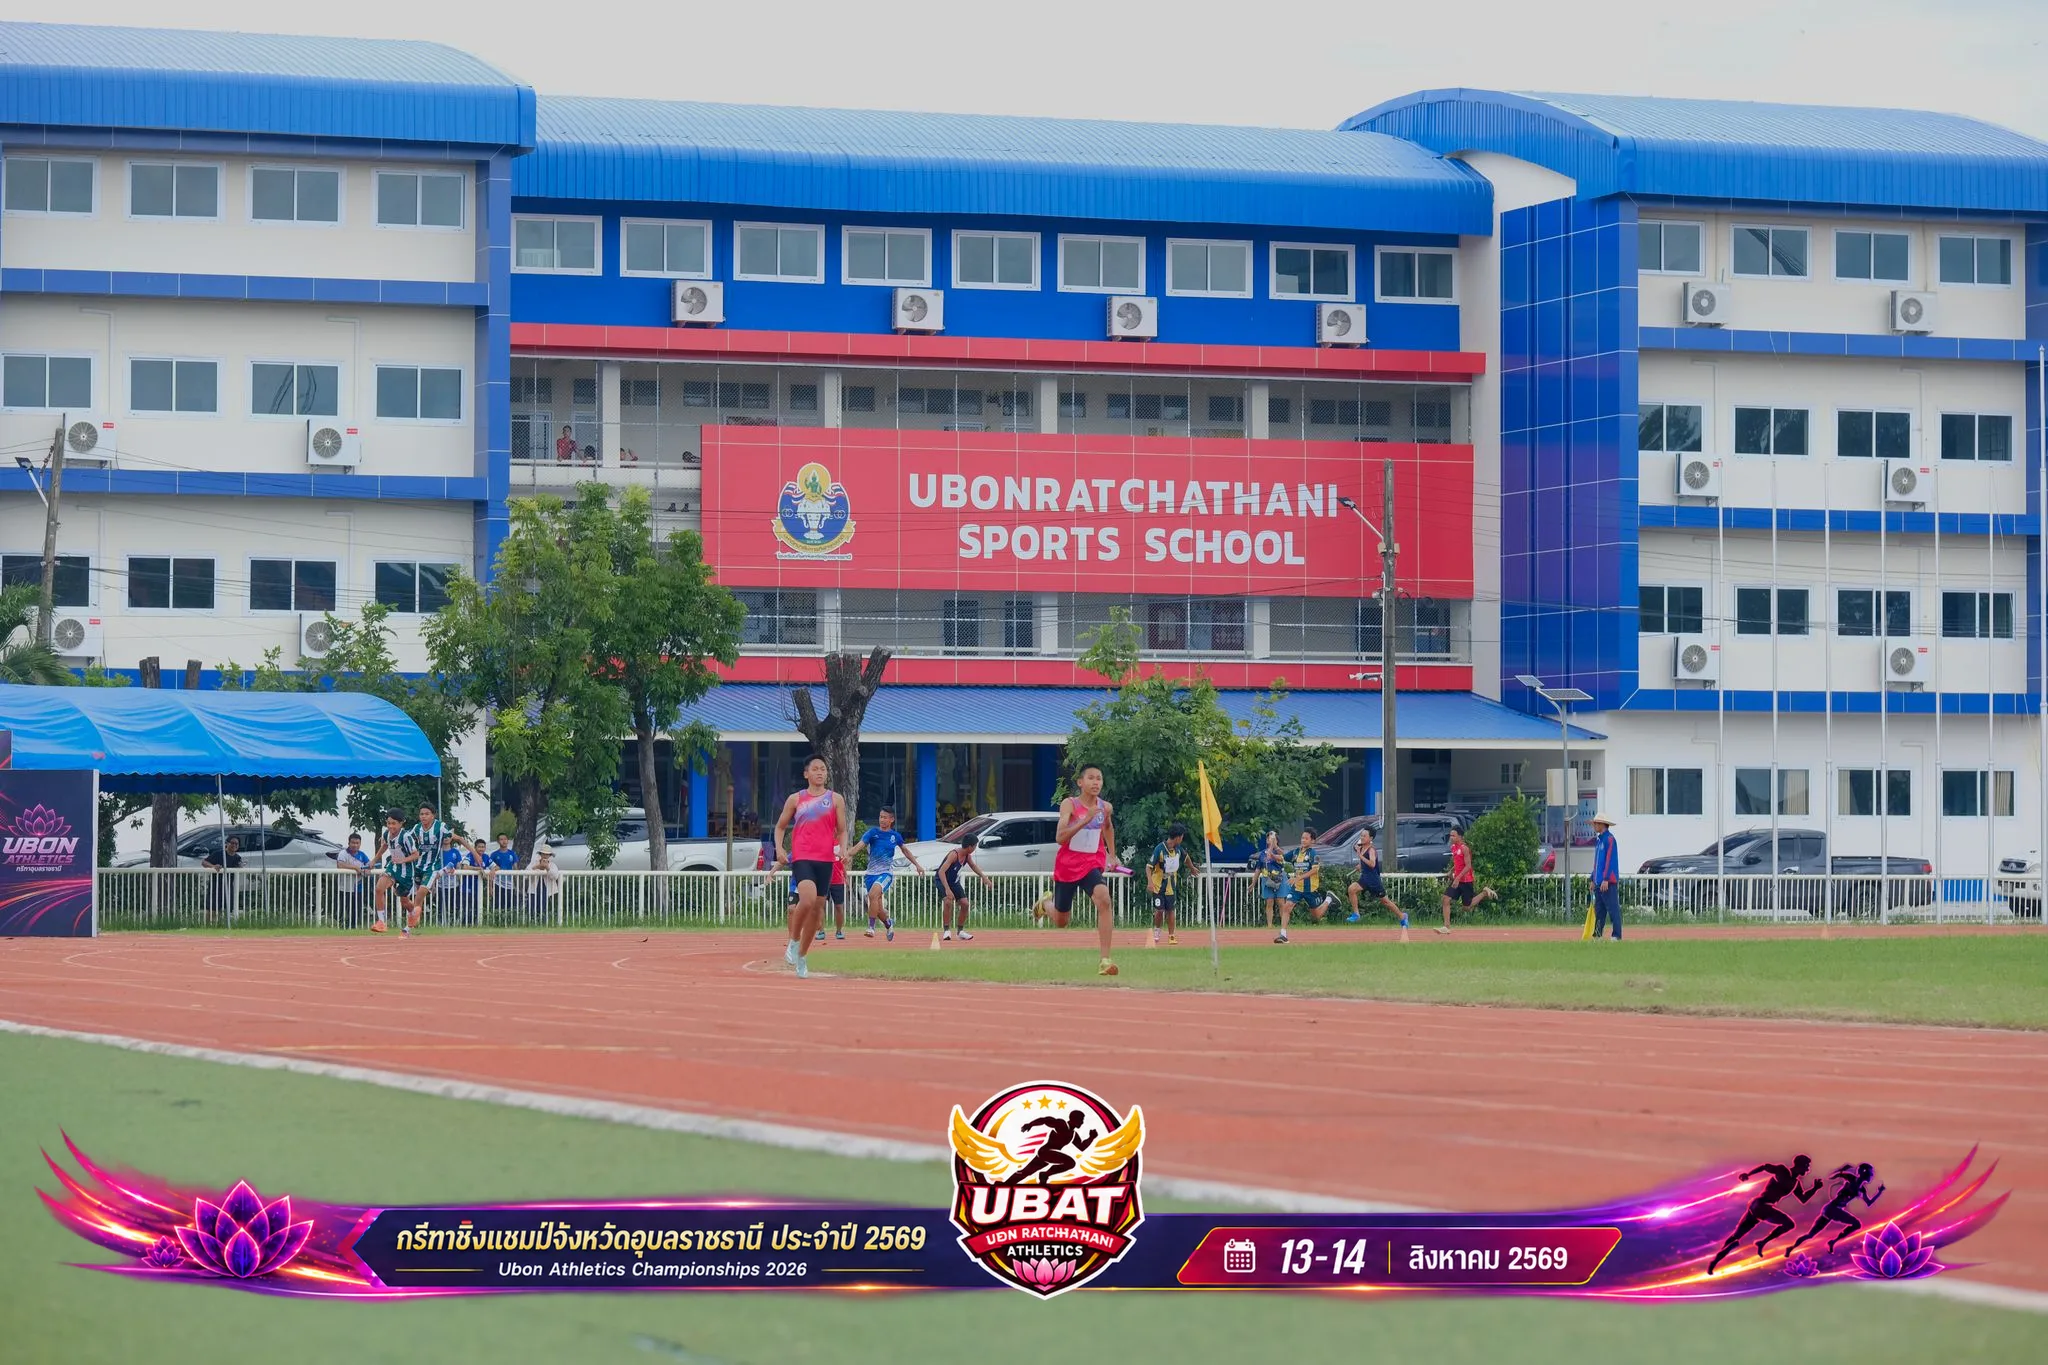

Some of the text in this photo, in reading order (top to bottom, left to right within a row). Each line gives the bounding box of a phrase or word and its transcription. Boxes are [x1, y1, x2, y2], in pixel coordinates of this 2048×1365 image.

[909, 473, 1338, 518] UBONRATCHATHANI
[959, 523, 1305, 565] SPORTS SCHOOL
[2, 837, 80, 854] UBON
[3, 854, 75, 865] ATHLETICS
